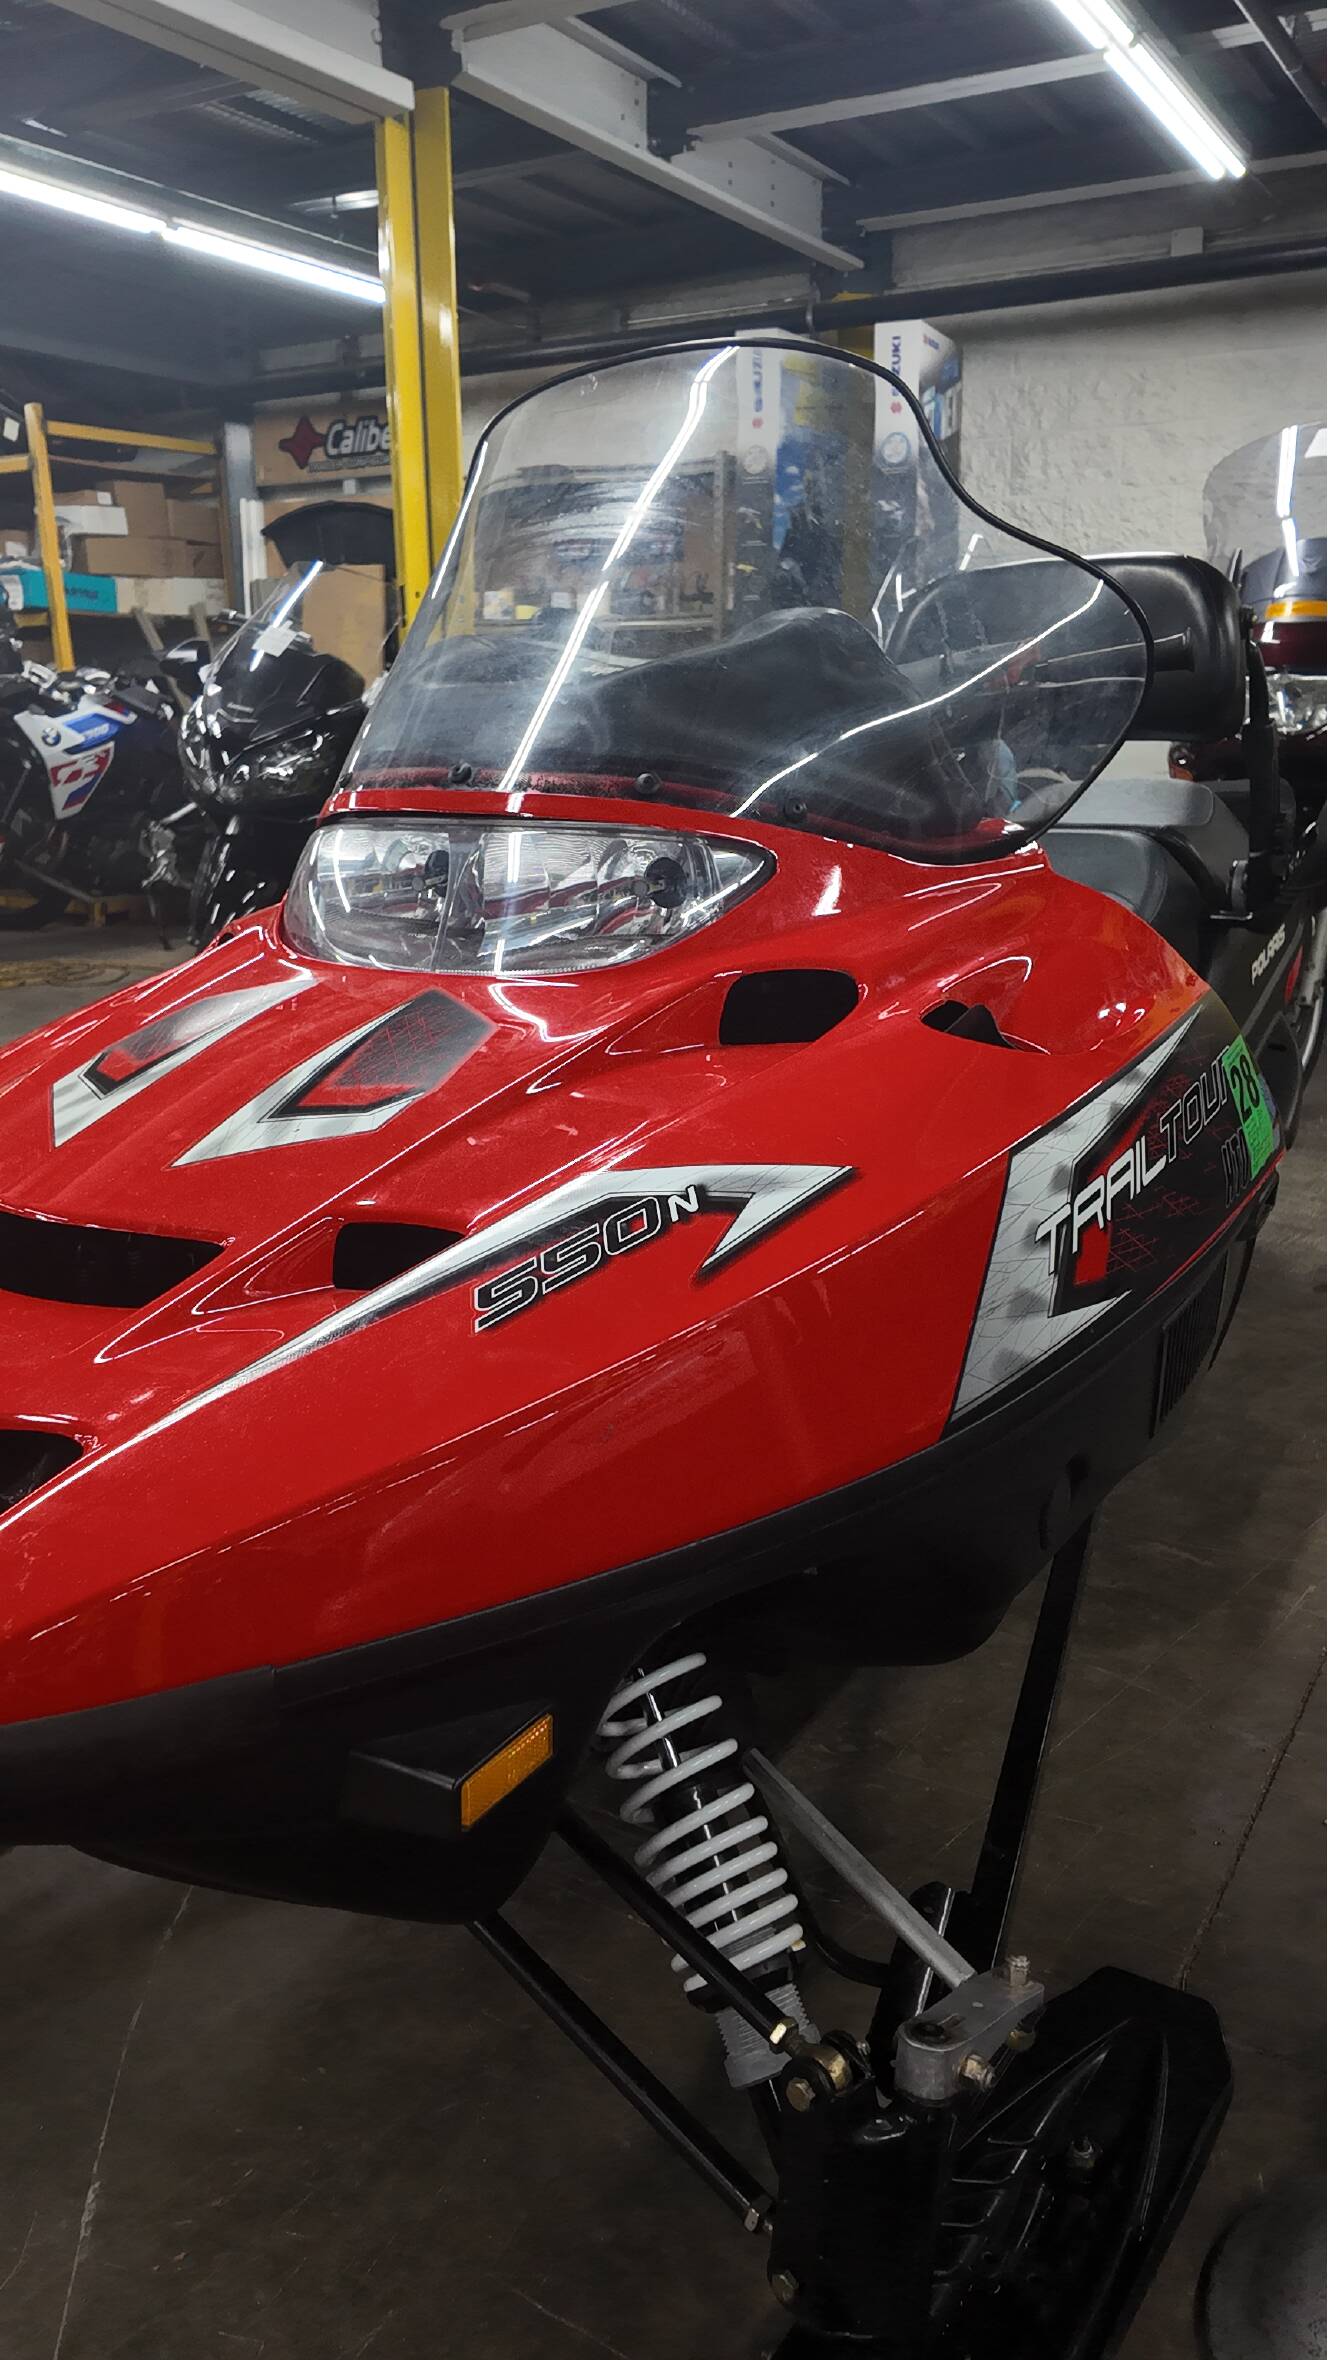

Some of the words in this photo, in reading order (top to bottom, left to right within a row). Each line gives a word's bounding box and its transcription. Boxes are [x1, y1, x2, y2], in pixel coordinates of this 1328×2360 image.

[325, 416, 391, 459] Calibe
[1251, 922, 1286, 986] POLARIS
[1230, 1054, 1261, 1122] 28
[1035, 1135, 1166, 1275] TRAIL
